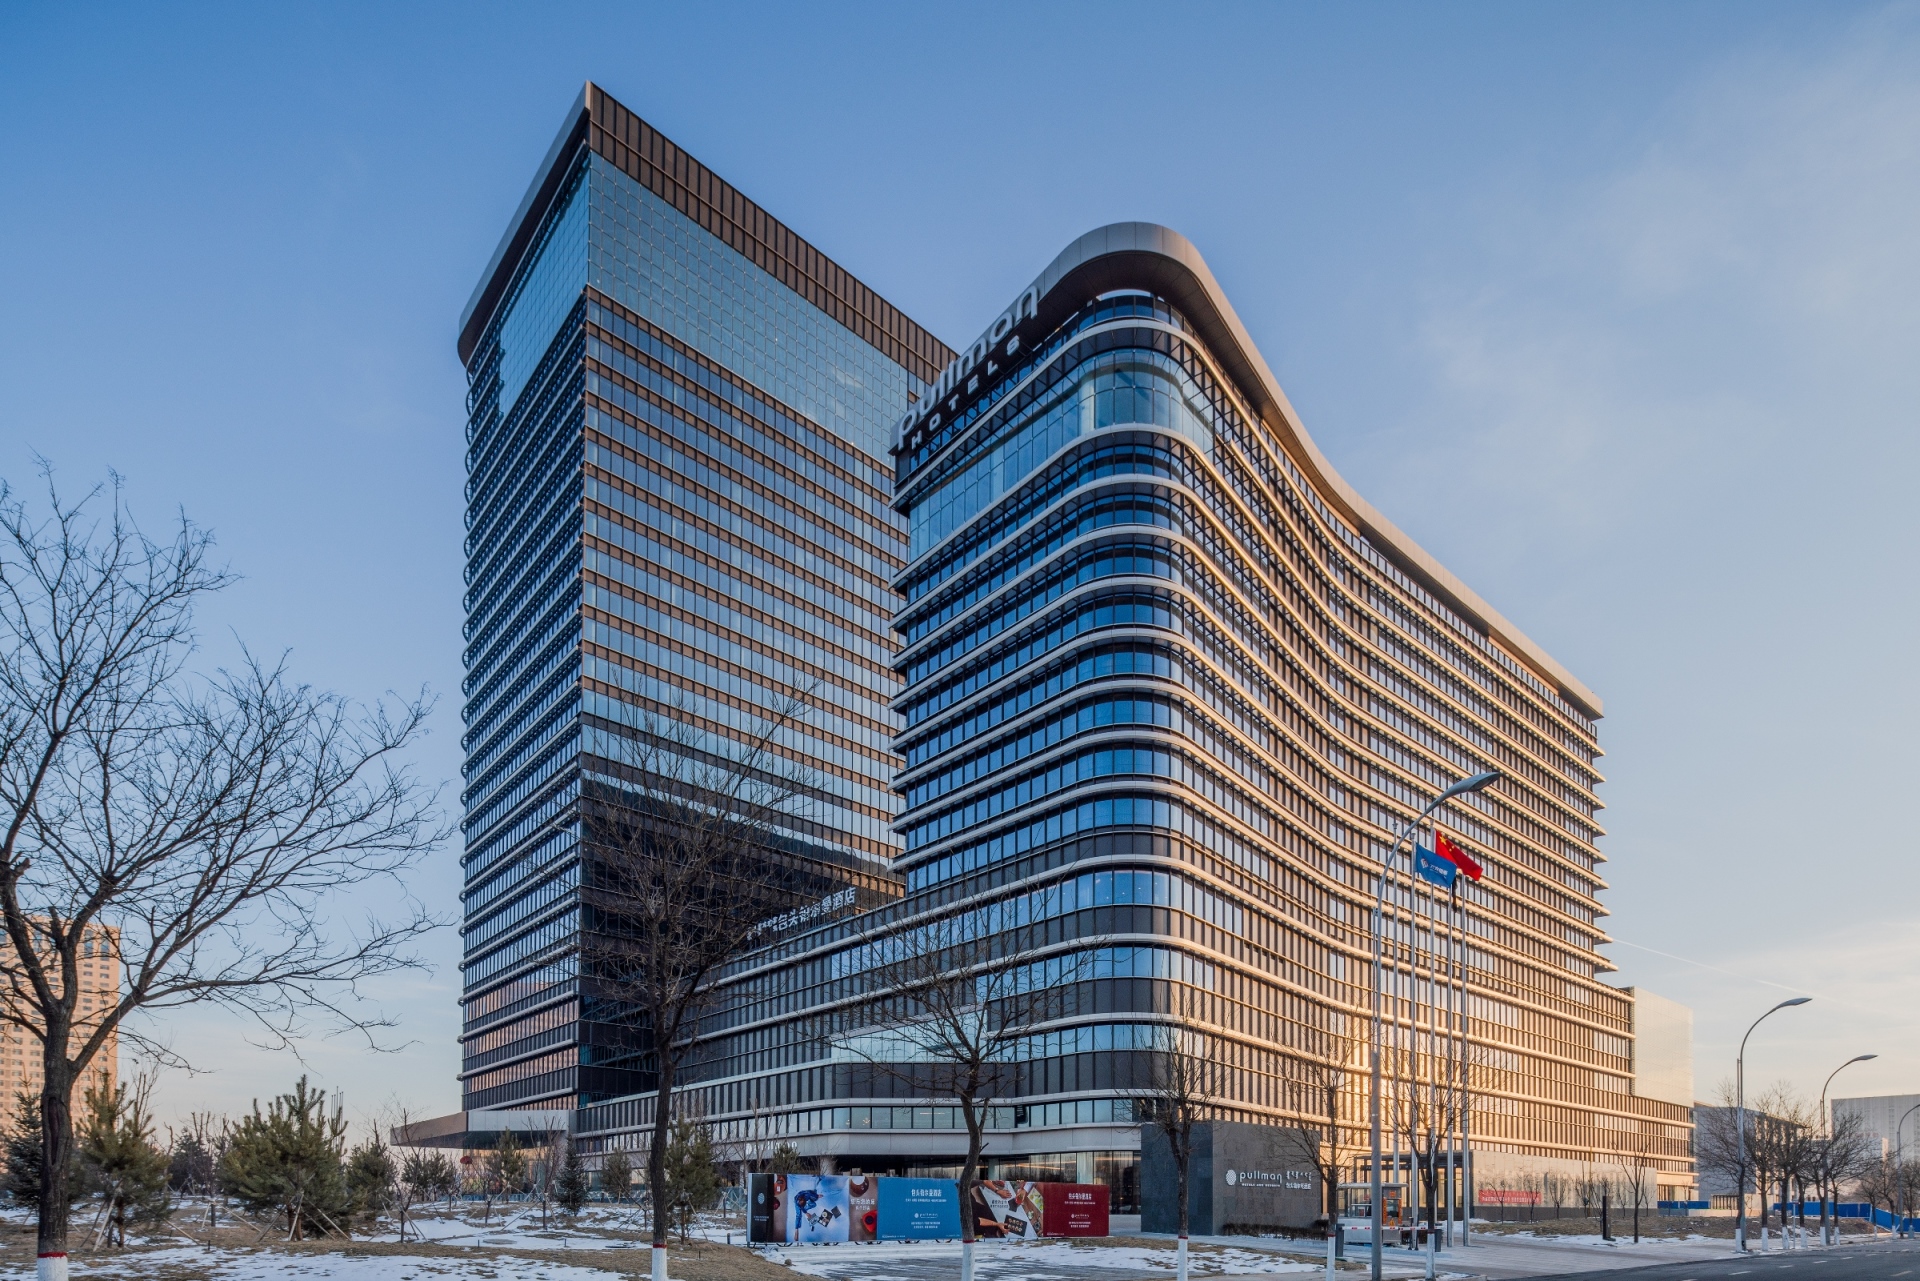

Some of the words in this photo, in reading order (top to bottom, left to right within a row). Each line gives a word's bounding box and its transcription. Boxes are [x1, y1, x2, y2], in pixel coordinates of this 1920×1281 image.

[897, 285, 1040, 452] pullman
[911, 335, 1020, 450] HOTELS
[1240, 1171, 1282, 1184] pullman
